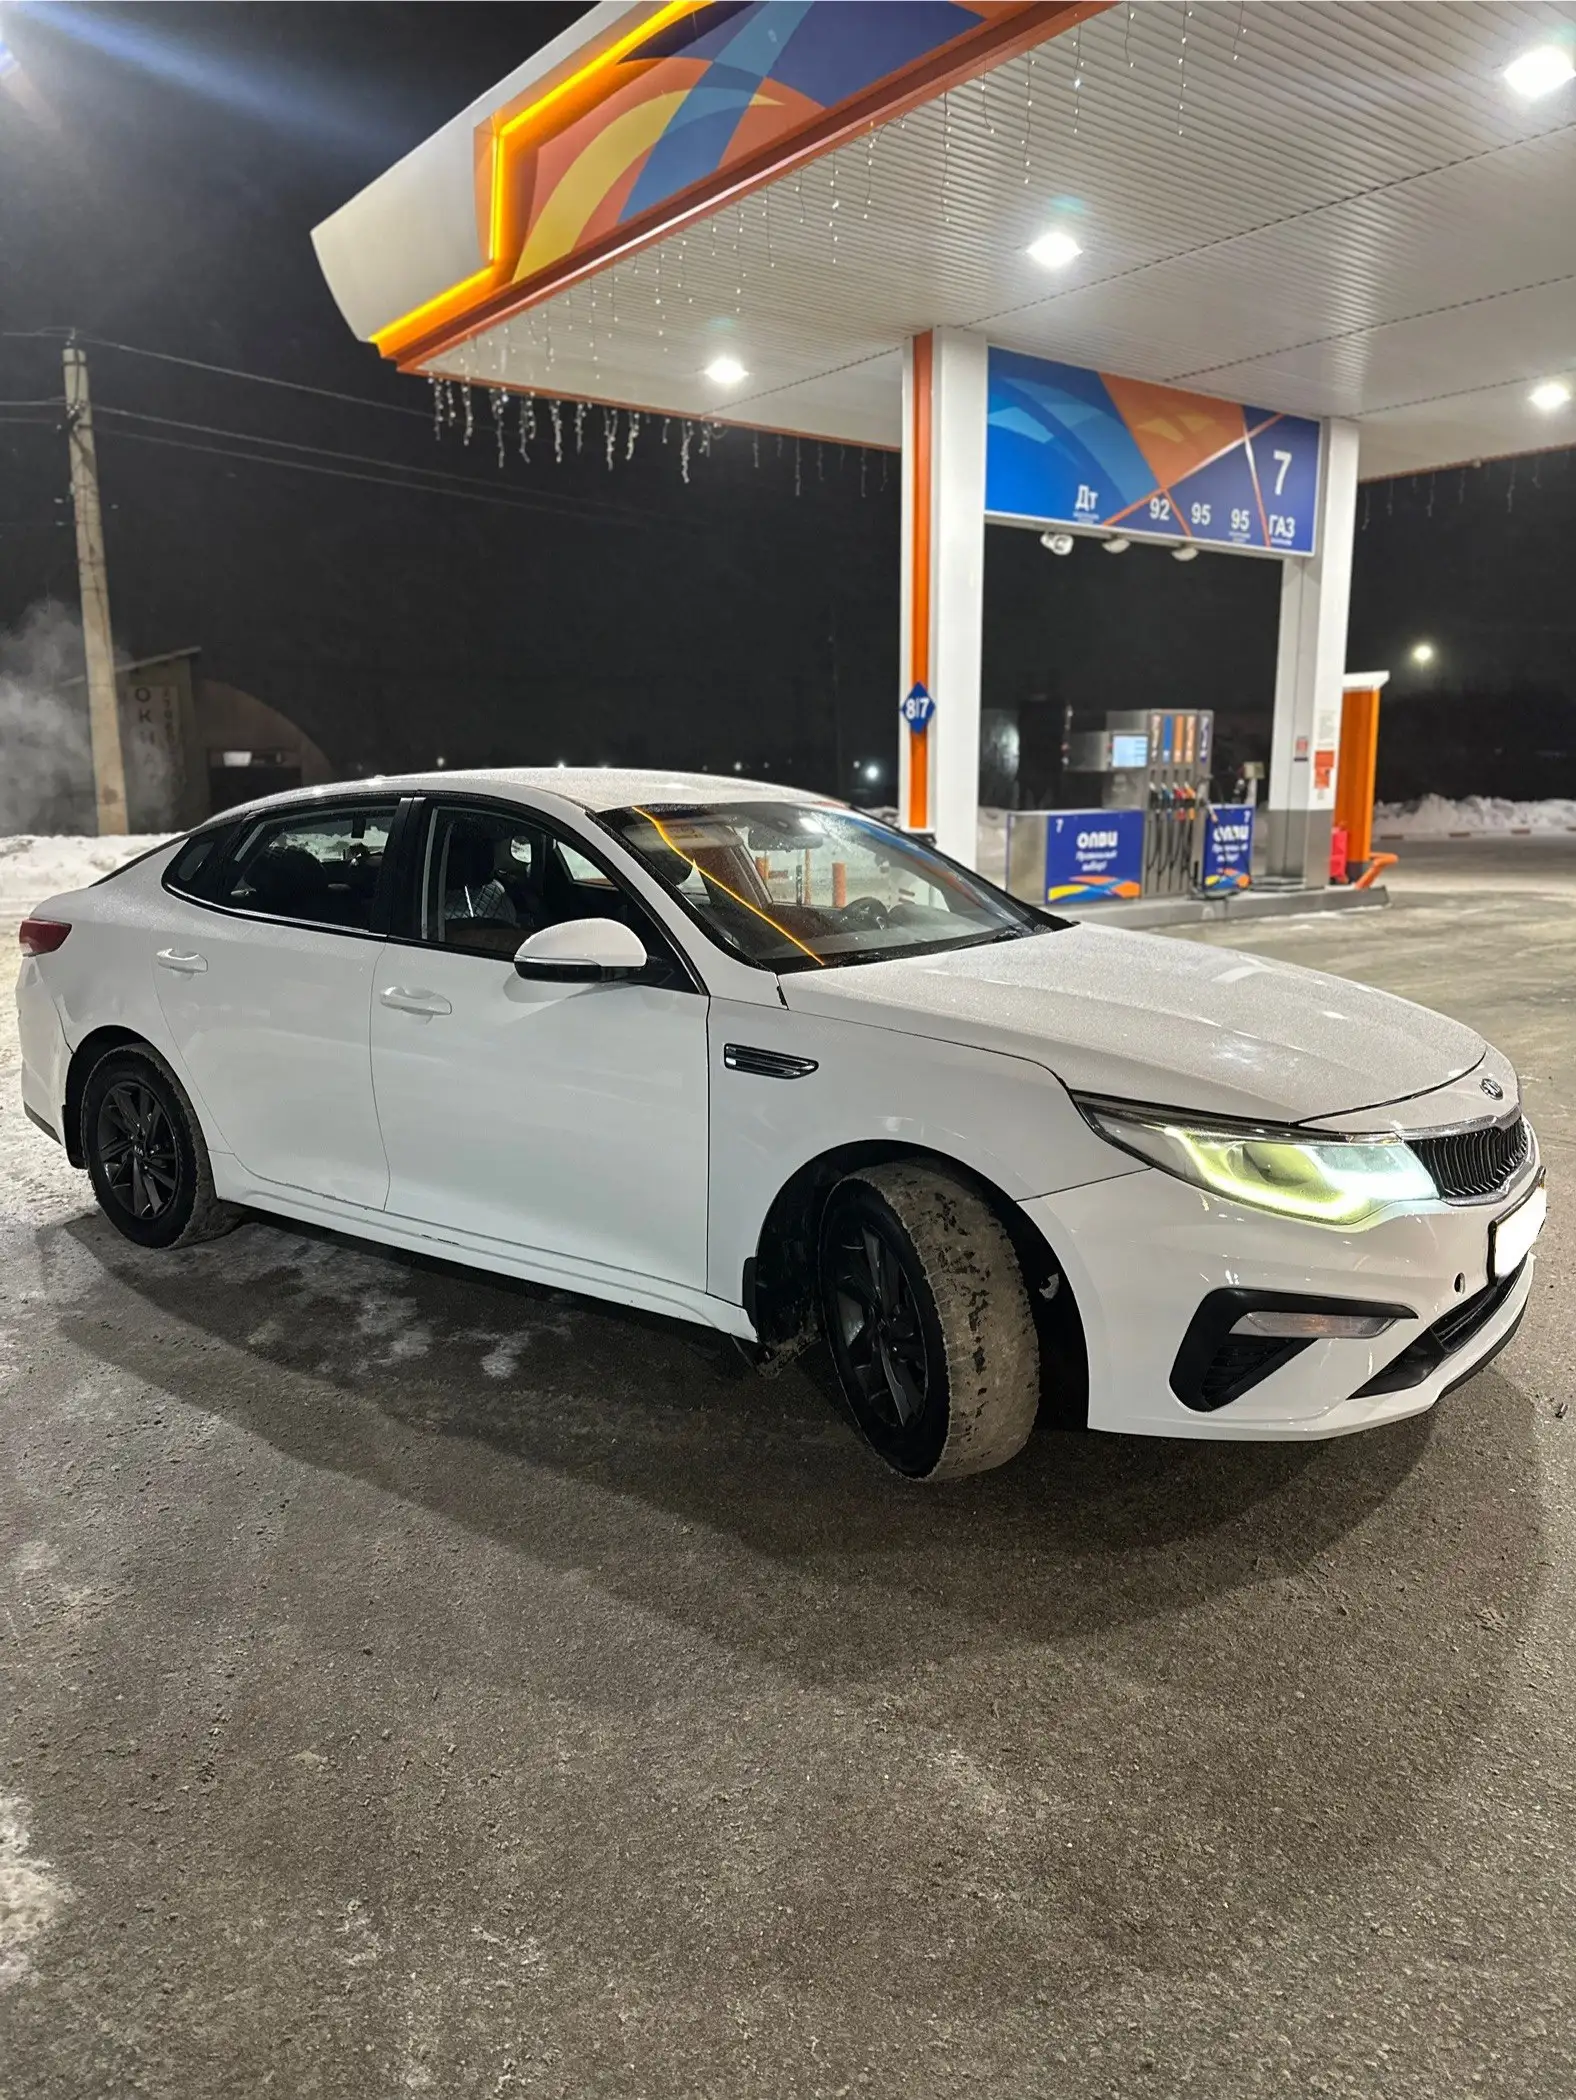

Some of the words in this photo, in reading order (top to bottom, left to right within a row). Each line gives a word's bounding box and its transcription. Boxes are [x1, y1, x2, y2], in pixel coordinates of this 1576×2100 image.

[1273, 449, 1292, 495] 7
[1149, 497, 1170, 520] 92
[1191, 502, 1211, 525] 95
[1230, 508, 1250, 531] 95
[1268, 514, 1296, 538] ГАЗ
[1055, 818, 1064, 833] 7
